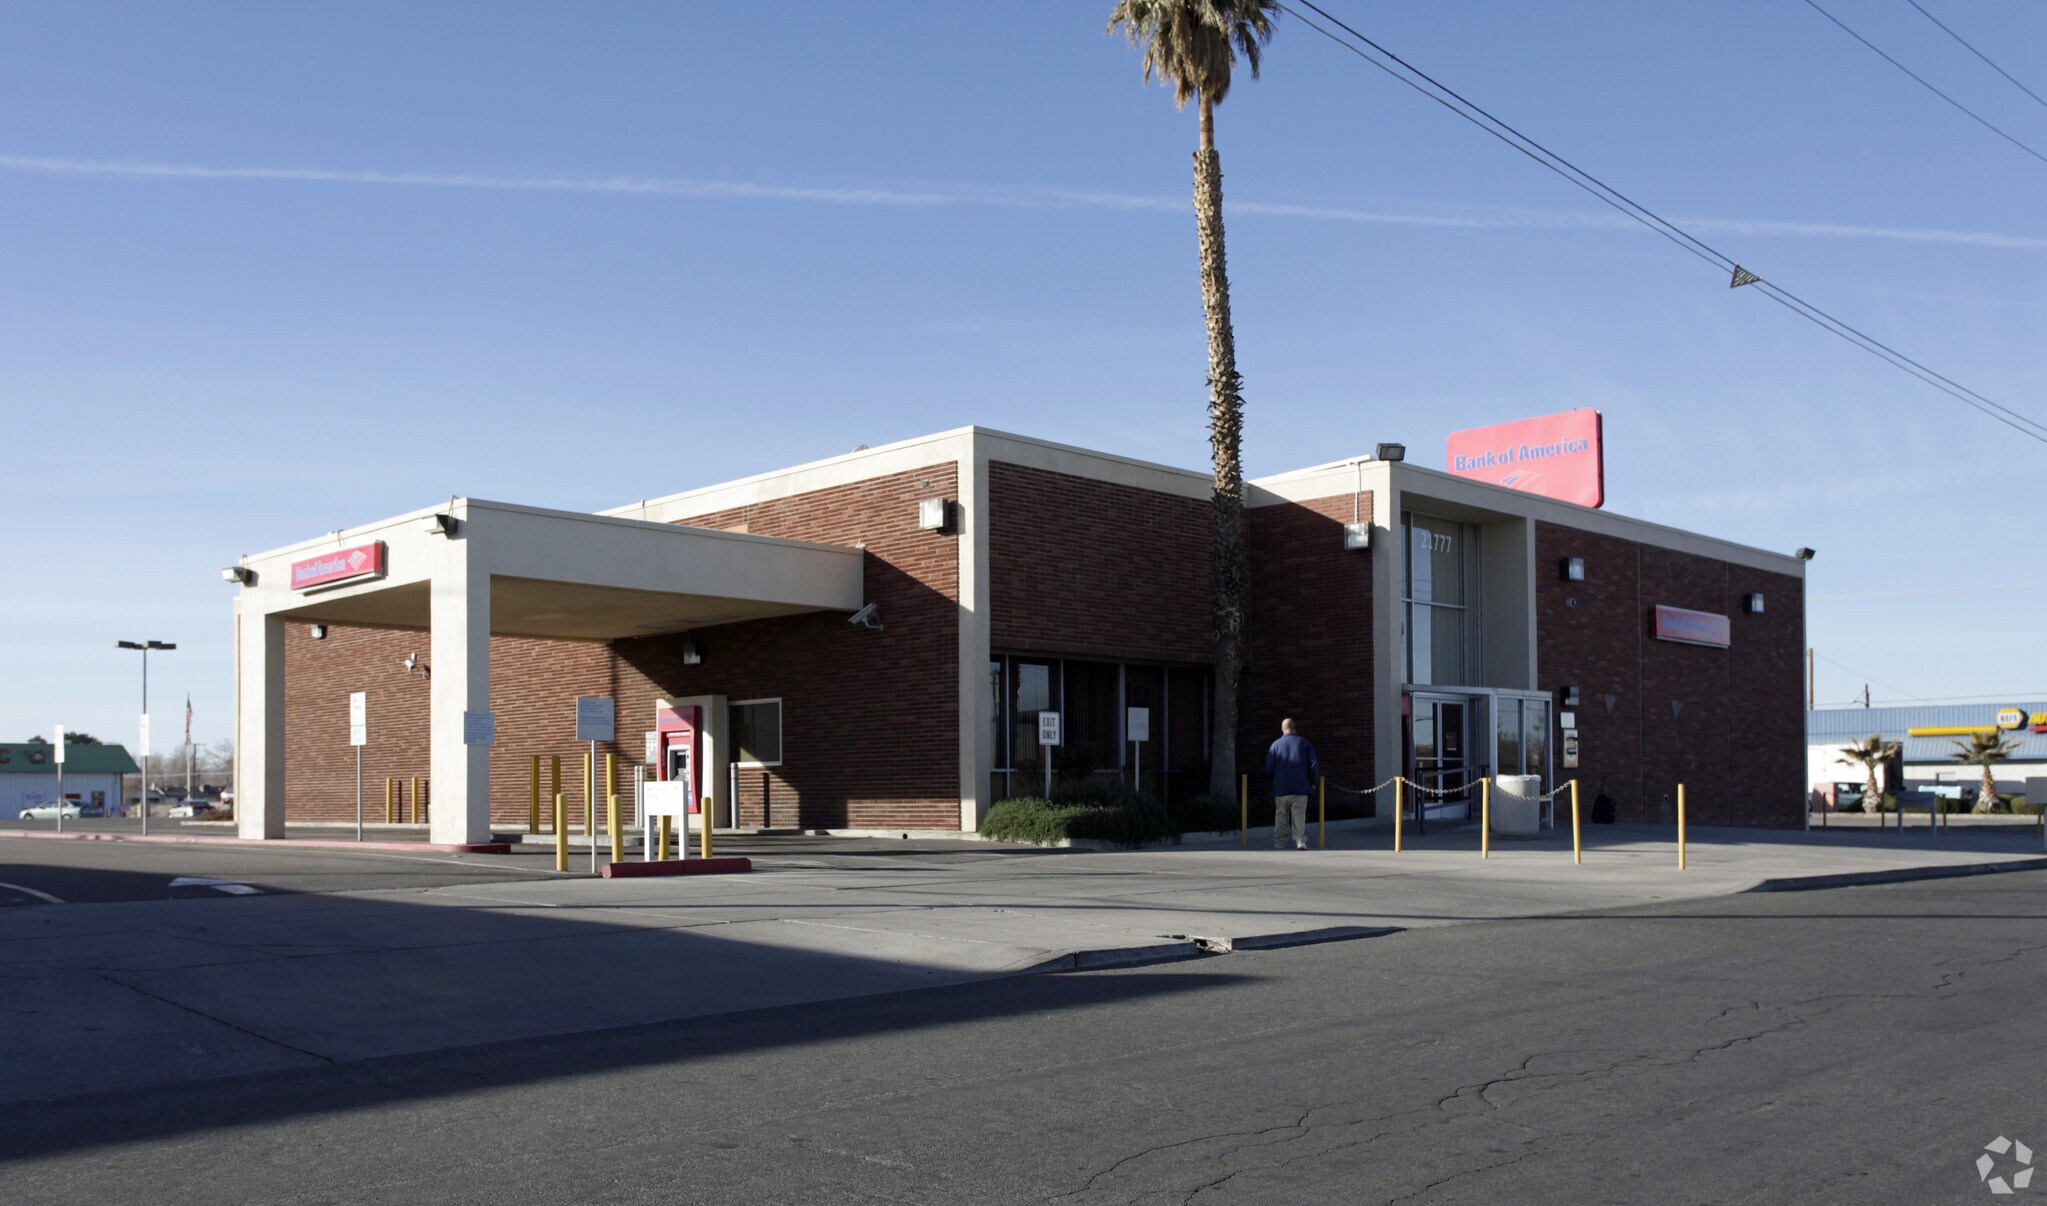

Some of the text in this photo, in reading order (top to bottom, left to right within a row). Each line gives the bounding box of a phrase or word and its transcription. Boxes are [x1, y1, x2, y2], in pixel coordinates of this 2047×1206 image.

[1455, 436, 1588, 472] Bank of America
[1421, 531, 1452, 553] 21777
[1042, 717, 1056, 727] EXIT
[2000, 713, 2019, 722] NAPA
[1042, 729, 1056, 740] ONLY
